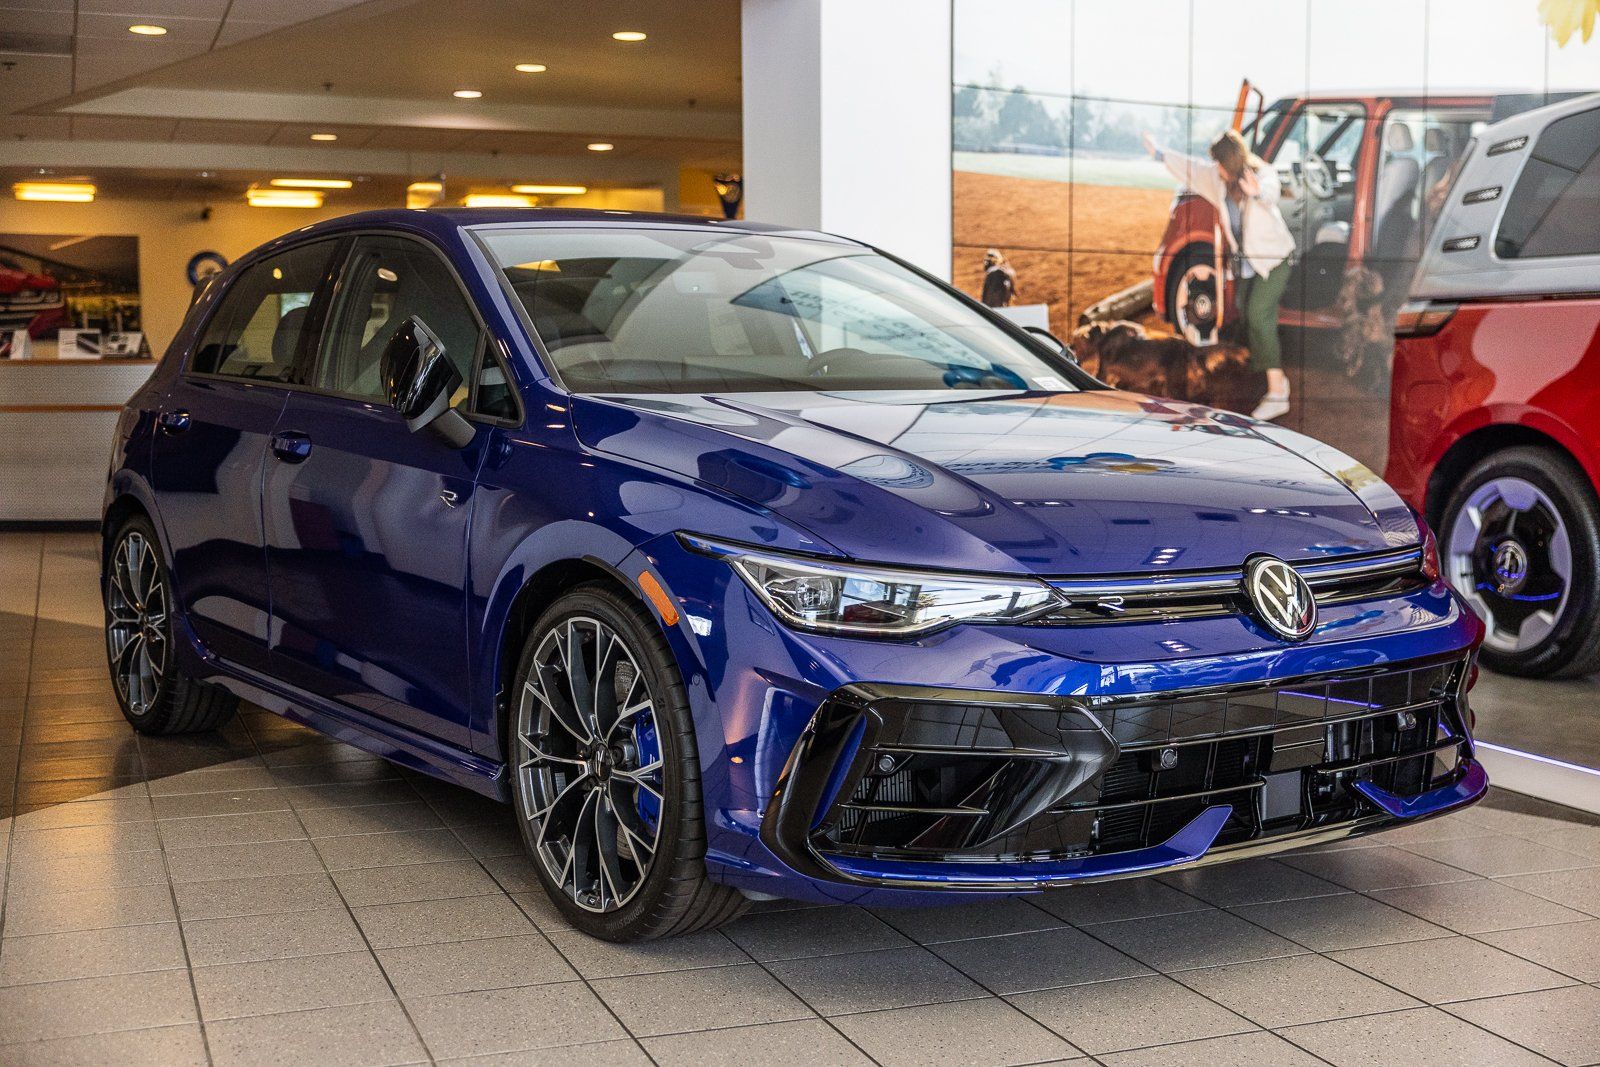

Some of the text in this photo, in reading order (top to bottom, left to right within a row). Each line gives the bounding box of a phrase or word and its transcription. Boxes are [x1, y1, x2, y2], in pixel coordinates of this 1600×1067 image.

[440, 489, 457, 508] R
[1098, 595, 1125, 611] R
[1255, 562, 1312, 631] VW
